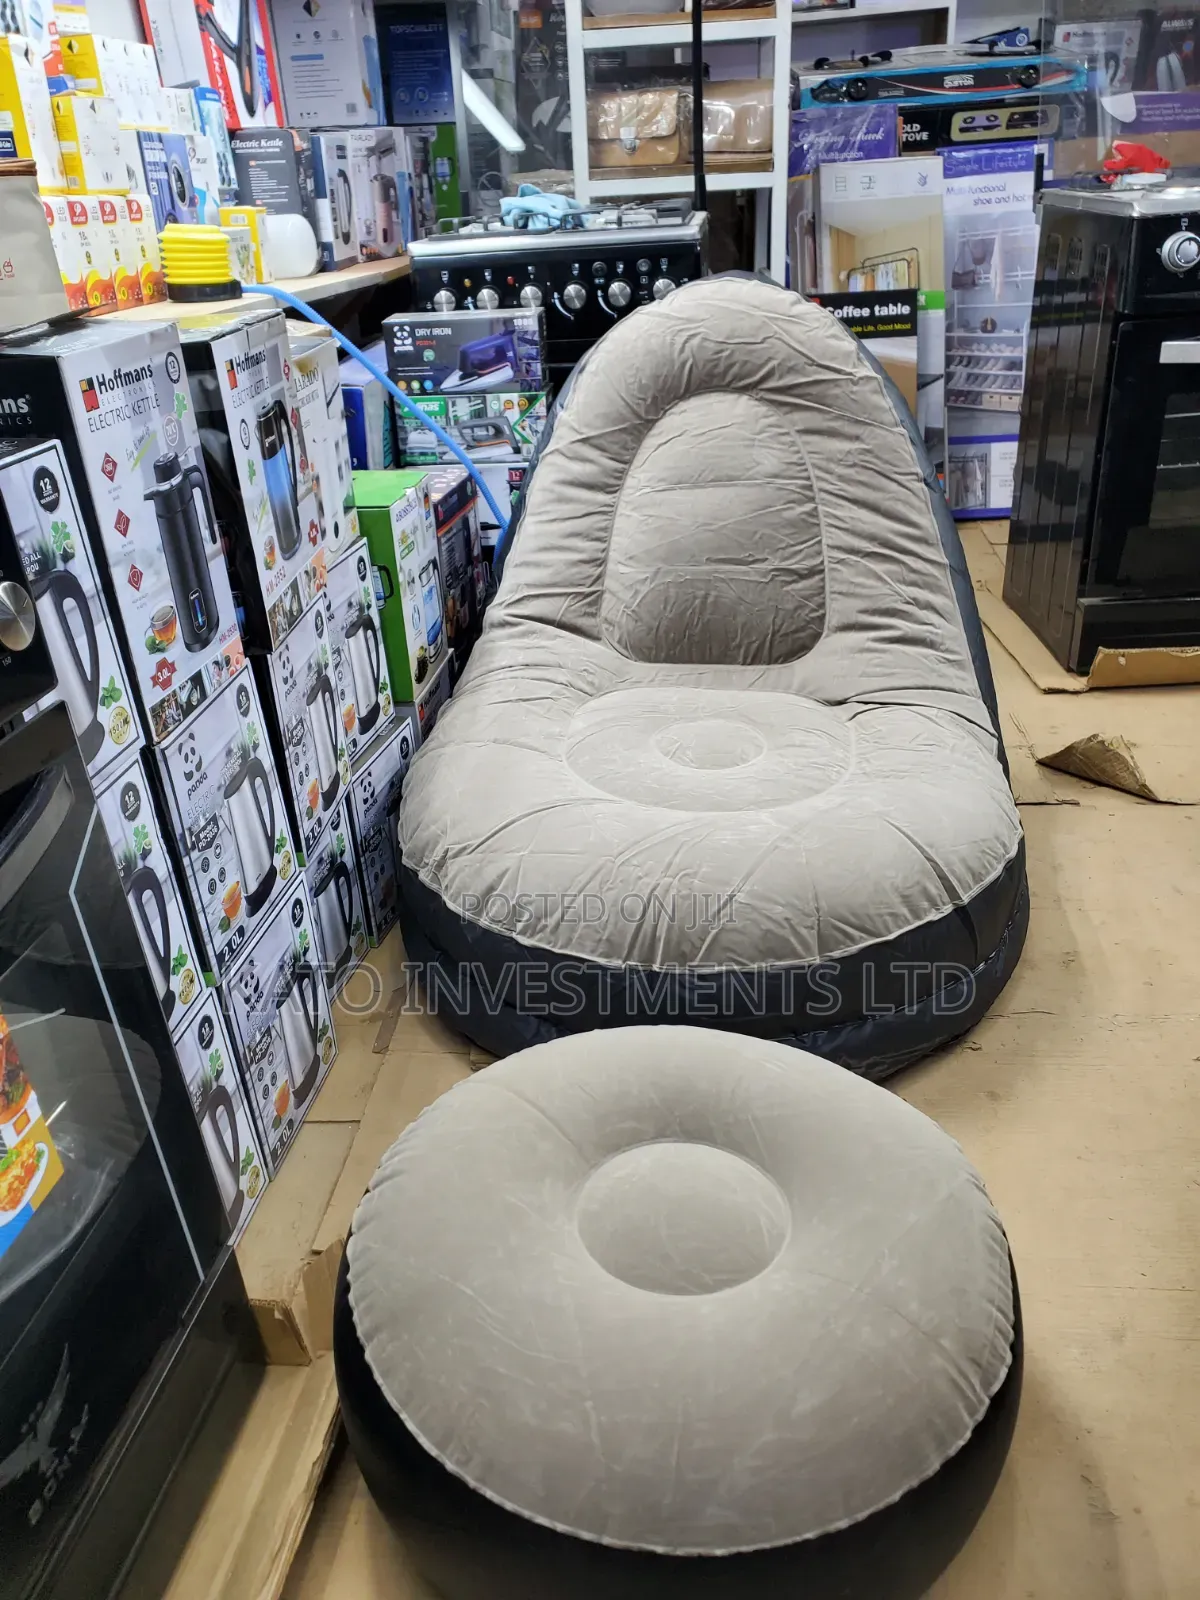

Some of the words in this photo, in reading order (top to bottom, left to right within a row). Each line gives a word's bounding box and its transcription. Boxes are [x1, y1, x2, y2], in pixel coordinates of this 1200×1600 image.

[231, 138, 260, 149] Electric
[260, 137, 284, 148] Kettle
[973, 195, 992, 206] shoe
[994, 193, 1010, 204] and
[873, 302, 912, 317] table
[415, 328, 431, 336] DRY
[432, 327, 452, 336] IRON
[877, 323, 893, 331] Good
[894, 322, 912, 330] Mood
[234, 349, 266, 376] Hoffmans
[96, 362, 154, 395] Hoffmans
[87, 405, 132, 433] ELECTRIC
[132, 393, 161, 417] KETTLE
[40, 477, 52, 491] 12
[2, 656, 12, 667] 150
[187, 770, 209, 801] panda
[124, 790, 135, 804] 12
[246, 990, 265, 1022] panda
